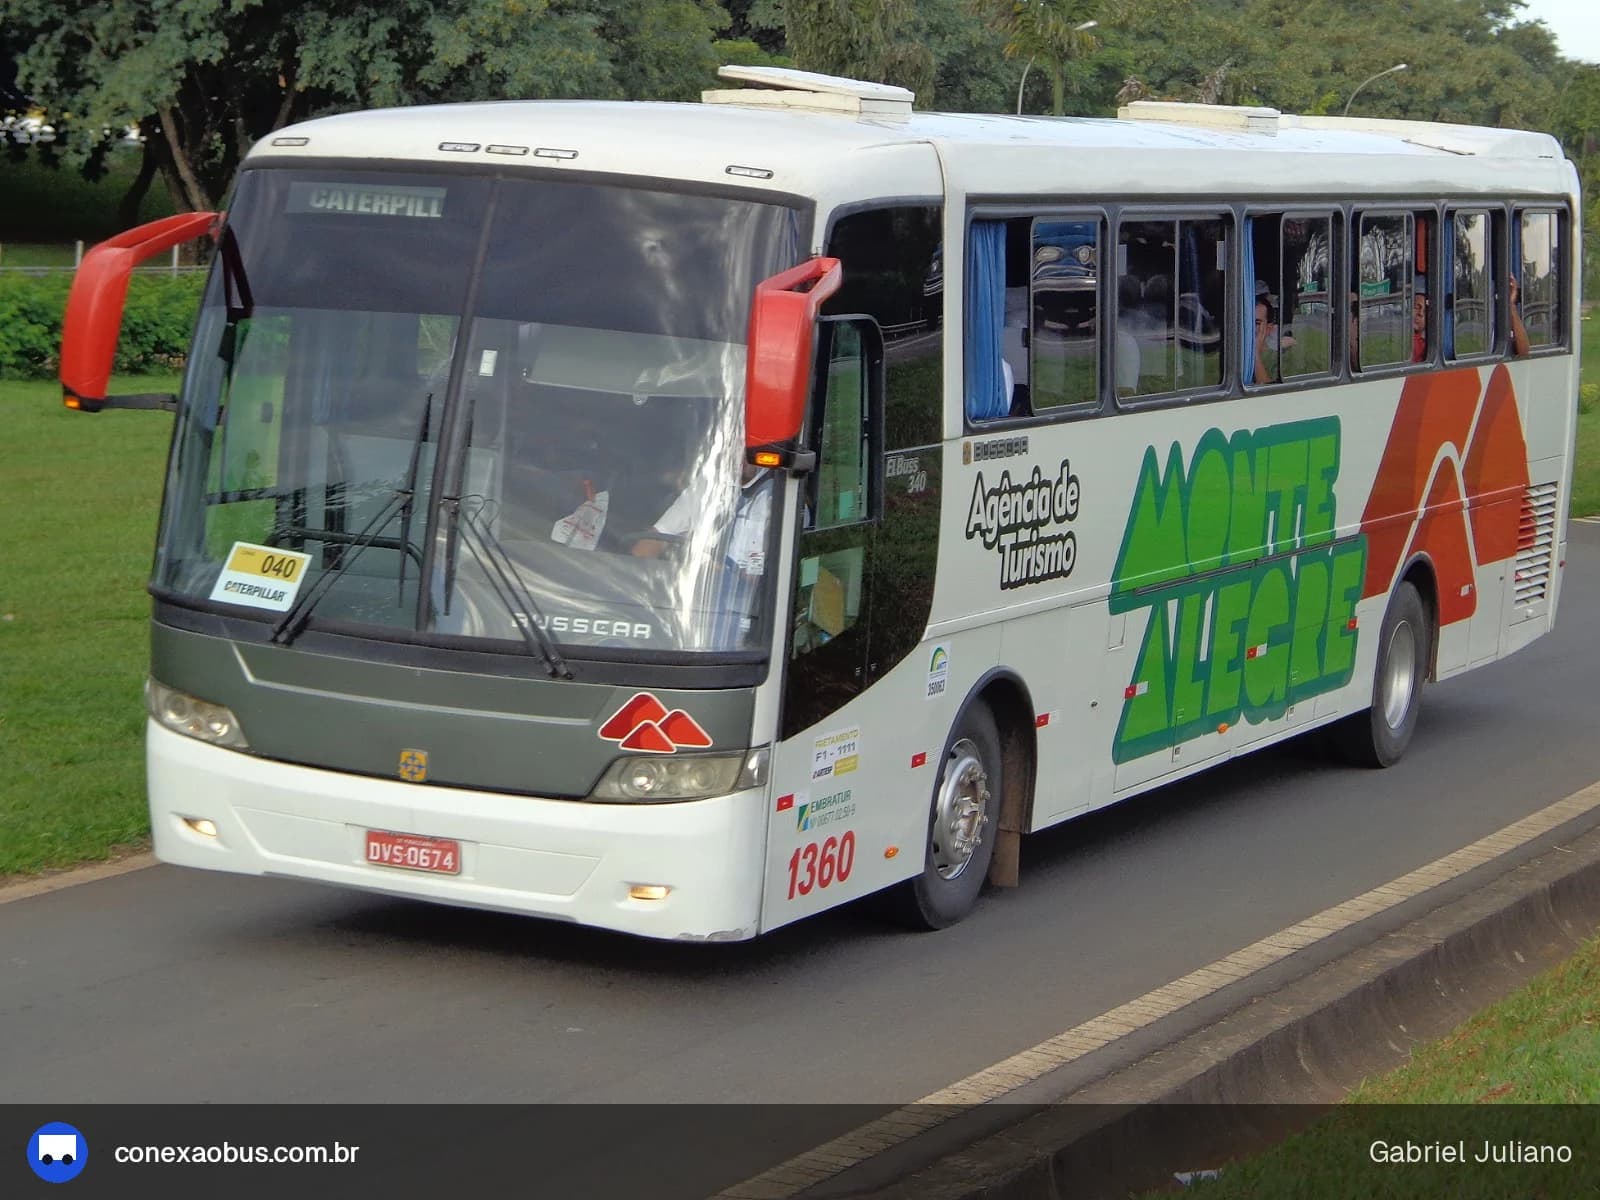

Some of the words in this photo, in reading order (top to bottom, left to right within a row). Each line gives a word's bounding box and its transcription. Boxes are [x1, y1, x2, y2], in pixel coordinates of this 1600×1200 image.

[308, 188, 442, 218] CATERPILL
[973, 436, 1029, 461] BUSSCAR
[907, 471, 927, 494] 340
[966, 465, 1052, 549] Agência
[1053, 459, 1079, 524] de
[1110, 415, 1341, 608] MONTE
[261, 555, 296, 578] 040
[999, 530, 1077, 590] Turismo
[224, 580, 286, 602] CATERPILLAR
[1112, 540, 1367, 764] ALEGRE
[810, 789, 852, 813] EMBRATUR
[788, 830, 855, 900] 1360
